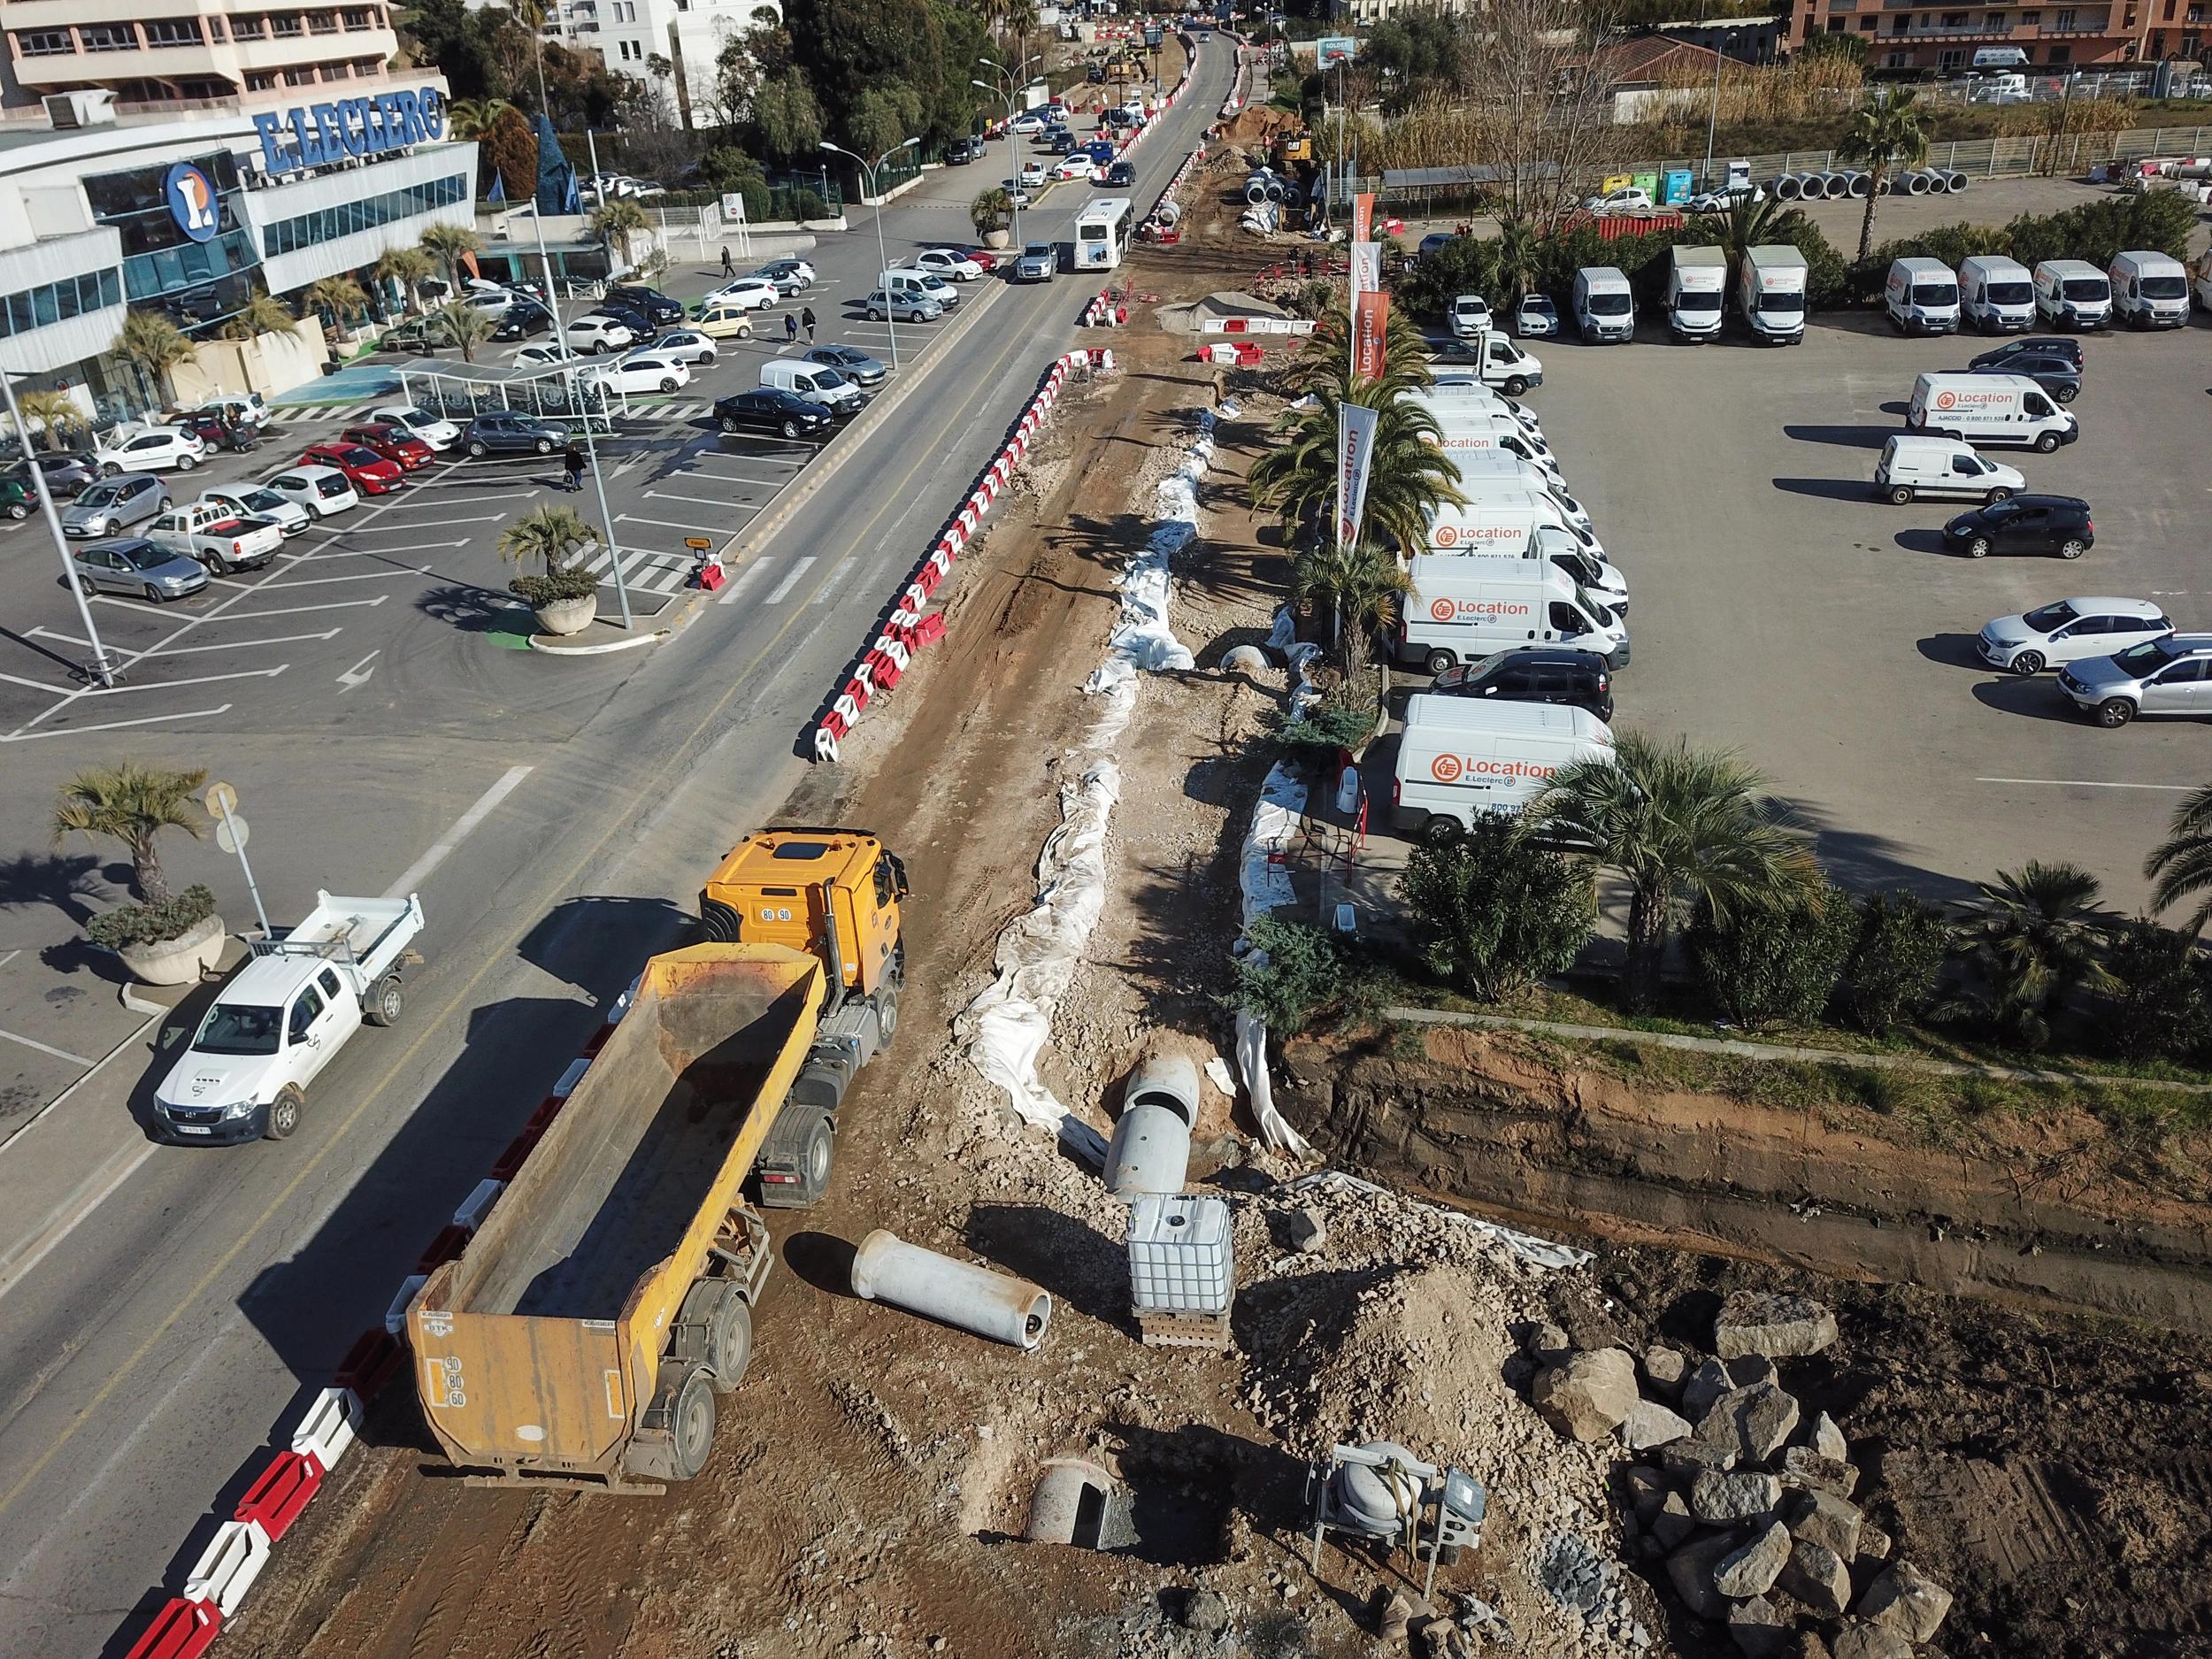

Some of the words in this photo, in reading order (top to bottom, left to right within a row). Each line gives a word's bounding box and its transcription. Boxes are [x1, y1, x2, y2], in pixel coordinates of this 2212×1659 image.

[1361, 257, 1370, 290] ation
[1361, 309, 1374, 372] Location
[1958, 392, 2013, 403] Location
[1341, 429, 1359, 514] Location
[1460, 526, 1522, 538] Location
[1458, 601, 1529, 615] Location
[1466, 757, 1556, 779] Location
[1465, 775, 1503, 785] E.Leclerc
[1491, 803, 1508, 812] 800
[763, 910, 772, 920] 80
[780, 910, 789, 920] 90
[447, 1357, 459, 1371] 90
[449, 1375, 462, 1388] 80
[451, 1393, 464, 1405] 60
